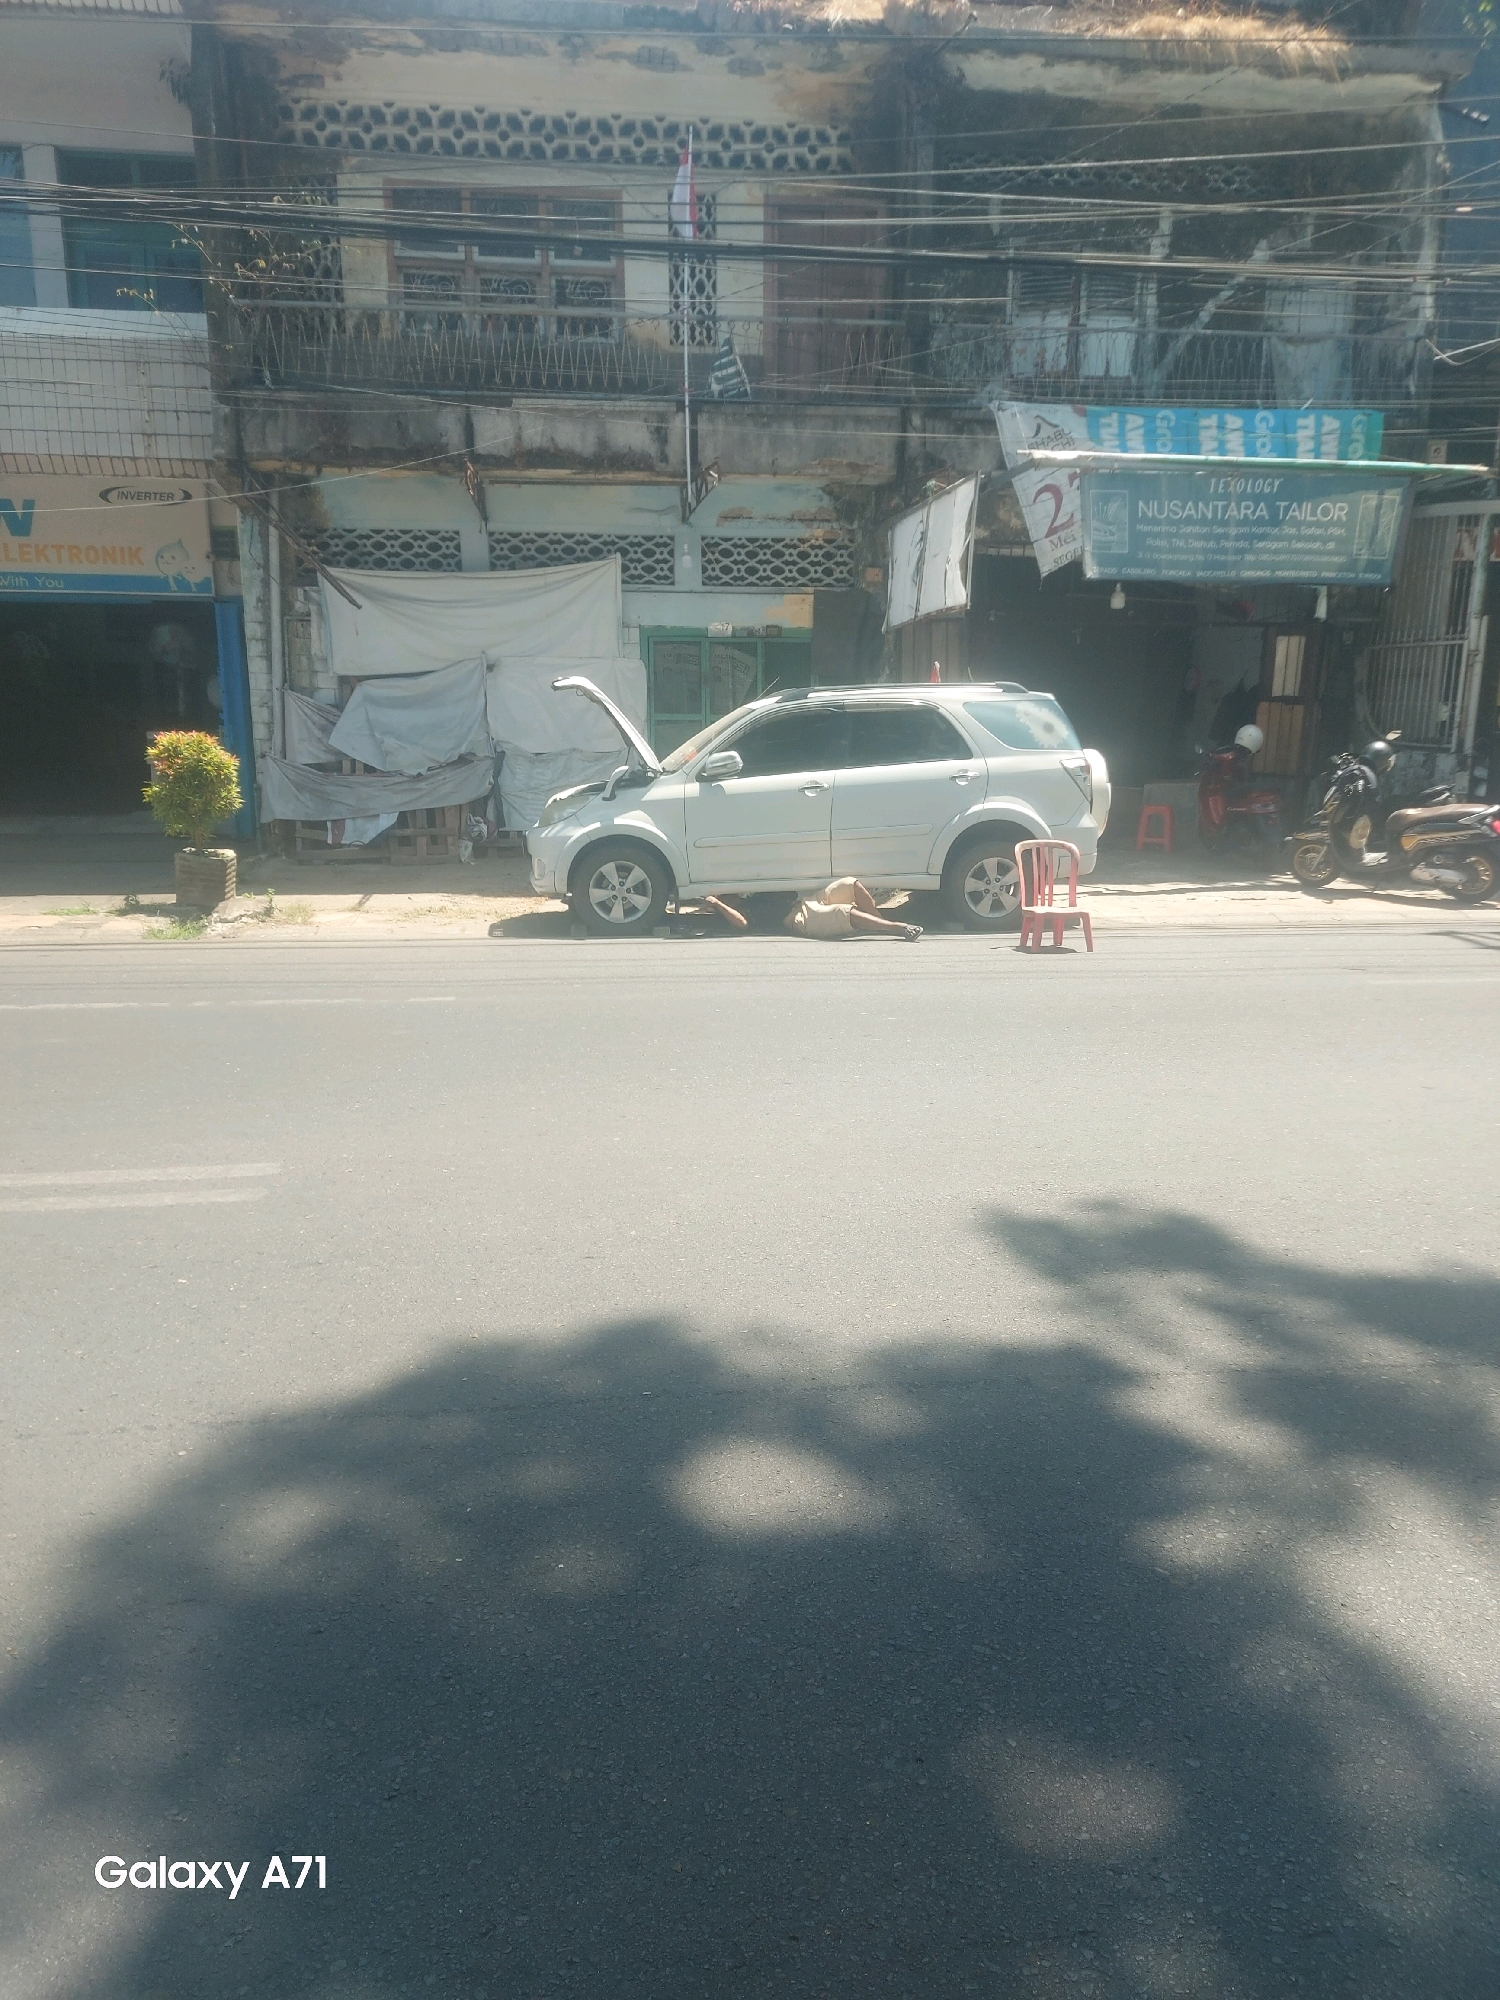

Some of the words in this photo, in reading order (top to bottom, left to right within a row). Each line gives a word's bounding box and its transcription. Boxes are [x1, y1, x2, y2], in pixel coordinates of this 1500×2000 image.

[1156, 409, 1177, 453] Gra
[1349, 414, 1368, 459] Gra
[116, 490, 175, 502] INVERTER
[1138, 500, 1269, 520] NUSANTARA
[1276, 501, 1349, 522] TAILOR
[1136, 524, 1177, 533] Menerima
[1179, 524, 1210, 534] Jahitan
[1212, 525, 1249, 536] Seragam
[1172, 538, 1187, 548] TNI,
[1253, 540, 1288, 550] Seragam
[0, 543, 144, 566] LEKTRONIK
[35, 576, 65, 588] You
